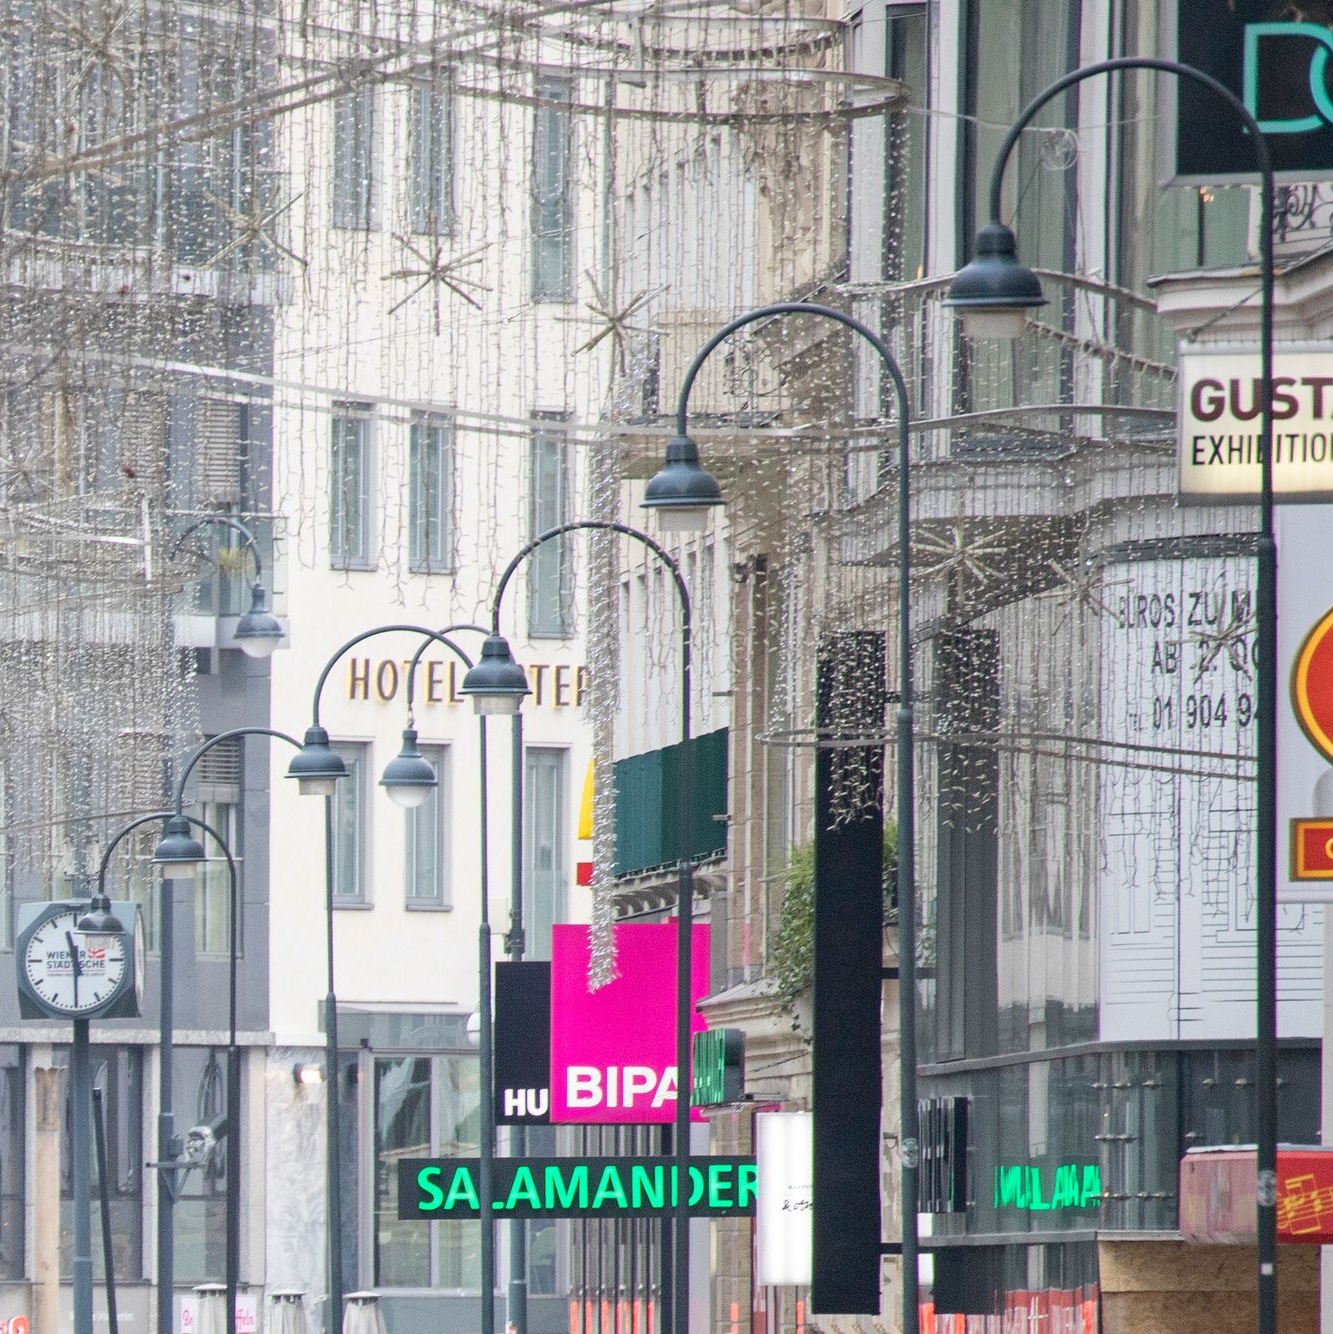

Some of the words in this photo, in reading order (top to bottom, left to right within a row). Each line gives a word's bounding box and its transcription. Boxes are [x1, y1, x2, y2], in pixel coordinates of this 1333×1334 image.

[1192, 434, 1333, 466] EXHIITIO
[349, 657, 465, 704] HOTEL
[566, 1065, 679, 1108] BIPA
